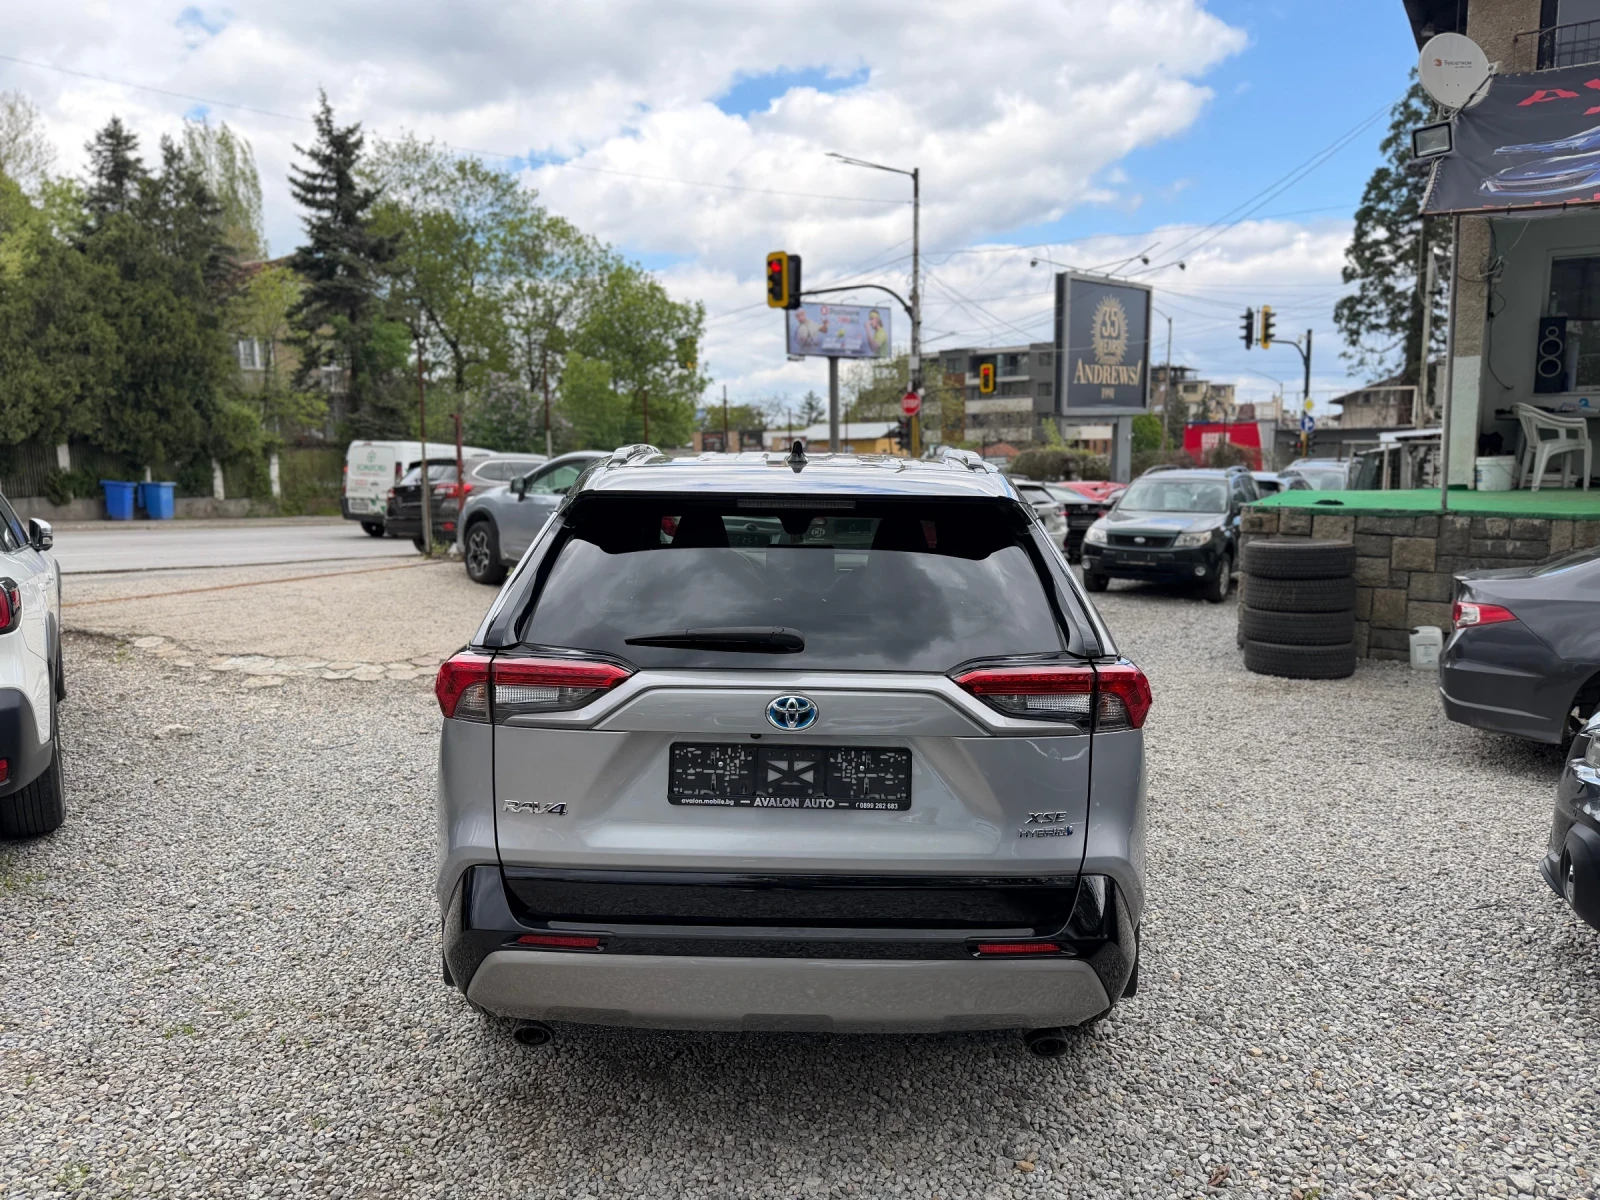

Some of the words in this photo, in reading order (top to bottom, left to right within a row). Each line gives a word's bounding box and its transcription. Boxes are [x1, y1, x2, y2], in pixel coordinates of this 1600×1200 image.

[1102, 307, 1119, 337] 35
[902, 399, 920, 408] STOP
[502, 799, 568, 816] RAV4
[681, 798, 735, 806] avalon.mobile.bg
[753, 797, 800, 808] AVALON
[803, 798, 836, 808] AUTO
[1024, 810, 1068, 825] XSE
[1018, 827, 1067, 838] HYBRID
